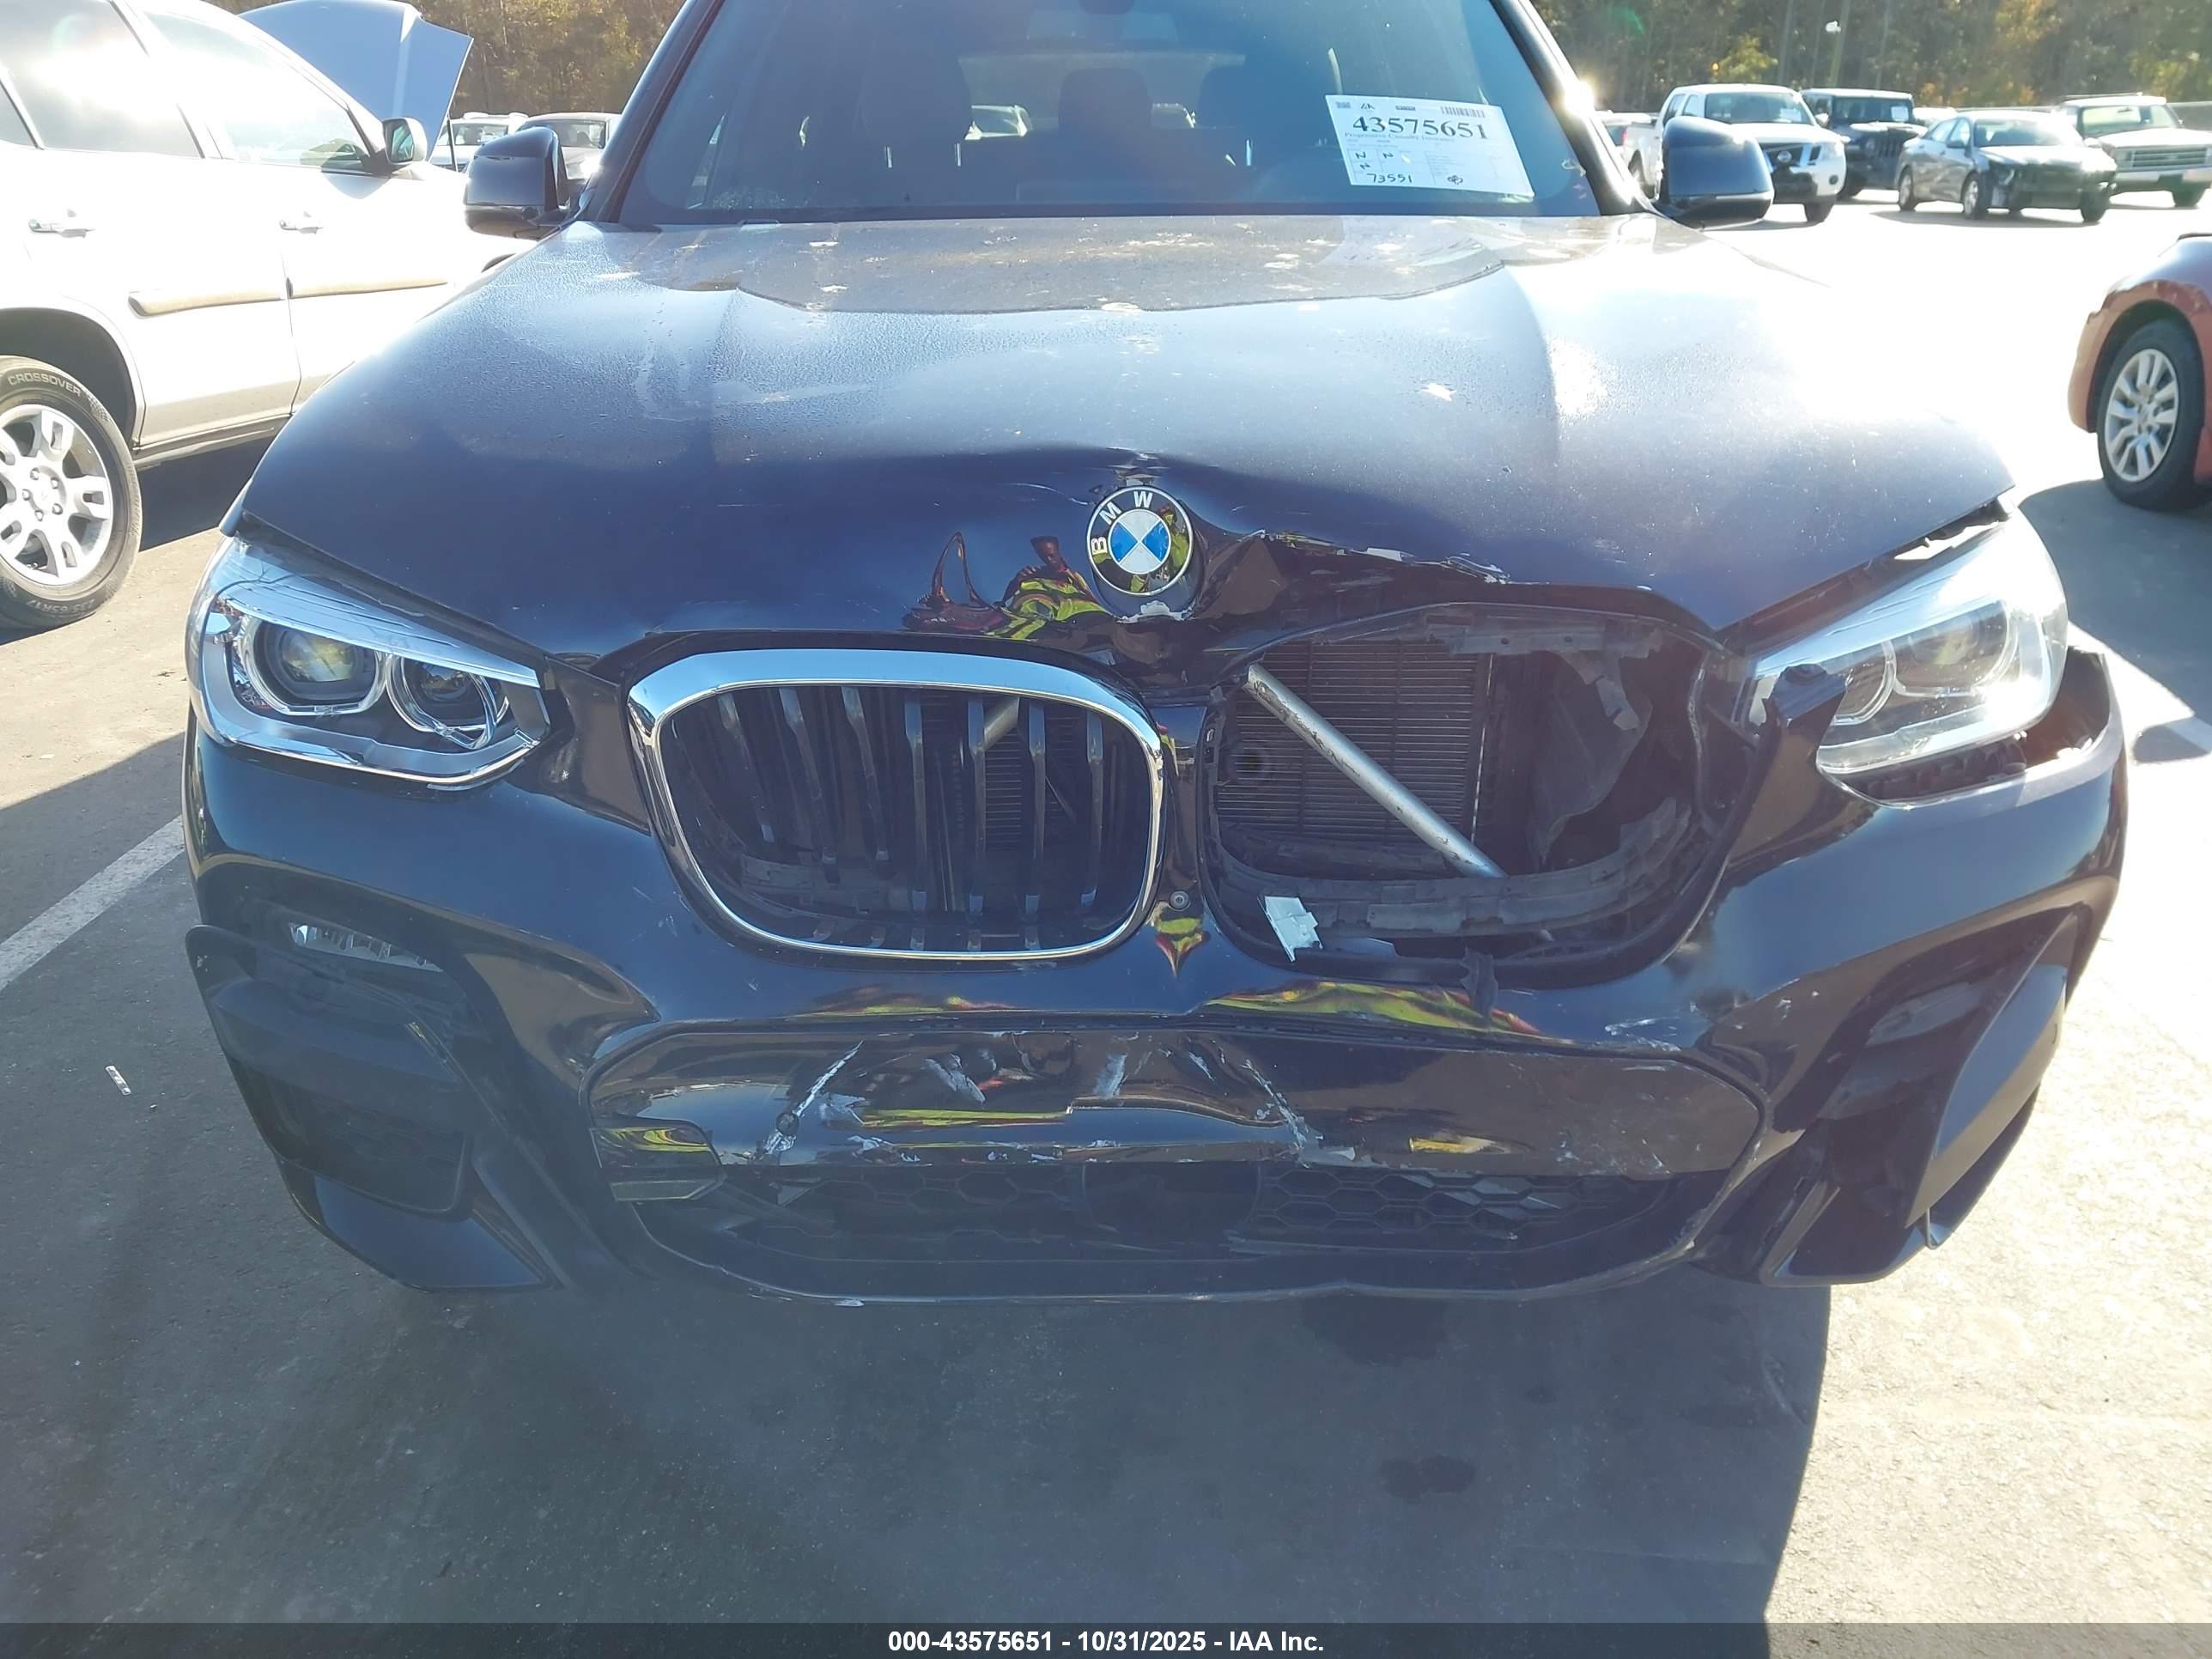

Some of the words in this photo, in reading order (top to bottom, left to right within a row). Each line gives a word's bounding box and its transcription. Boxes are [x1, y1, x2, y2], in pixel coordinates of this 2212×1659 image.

[1352, 116, 1488, 139] 43575651
[1366, 173, 1413, 184] 73551
[7, 372, 82, 397] CROSSOVER
[1091, 490, 1153, 556] BMW
